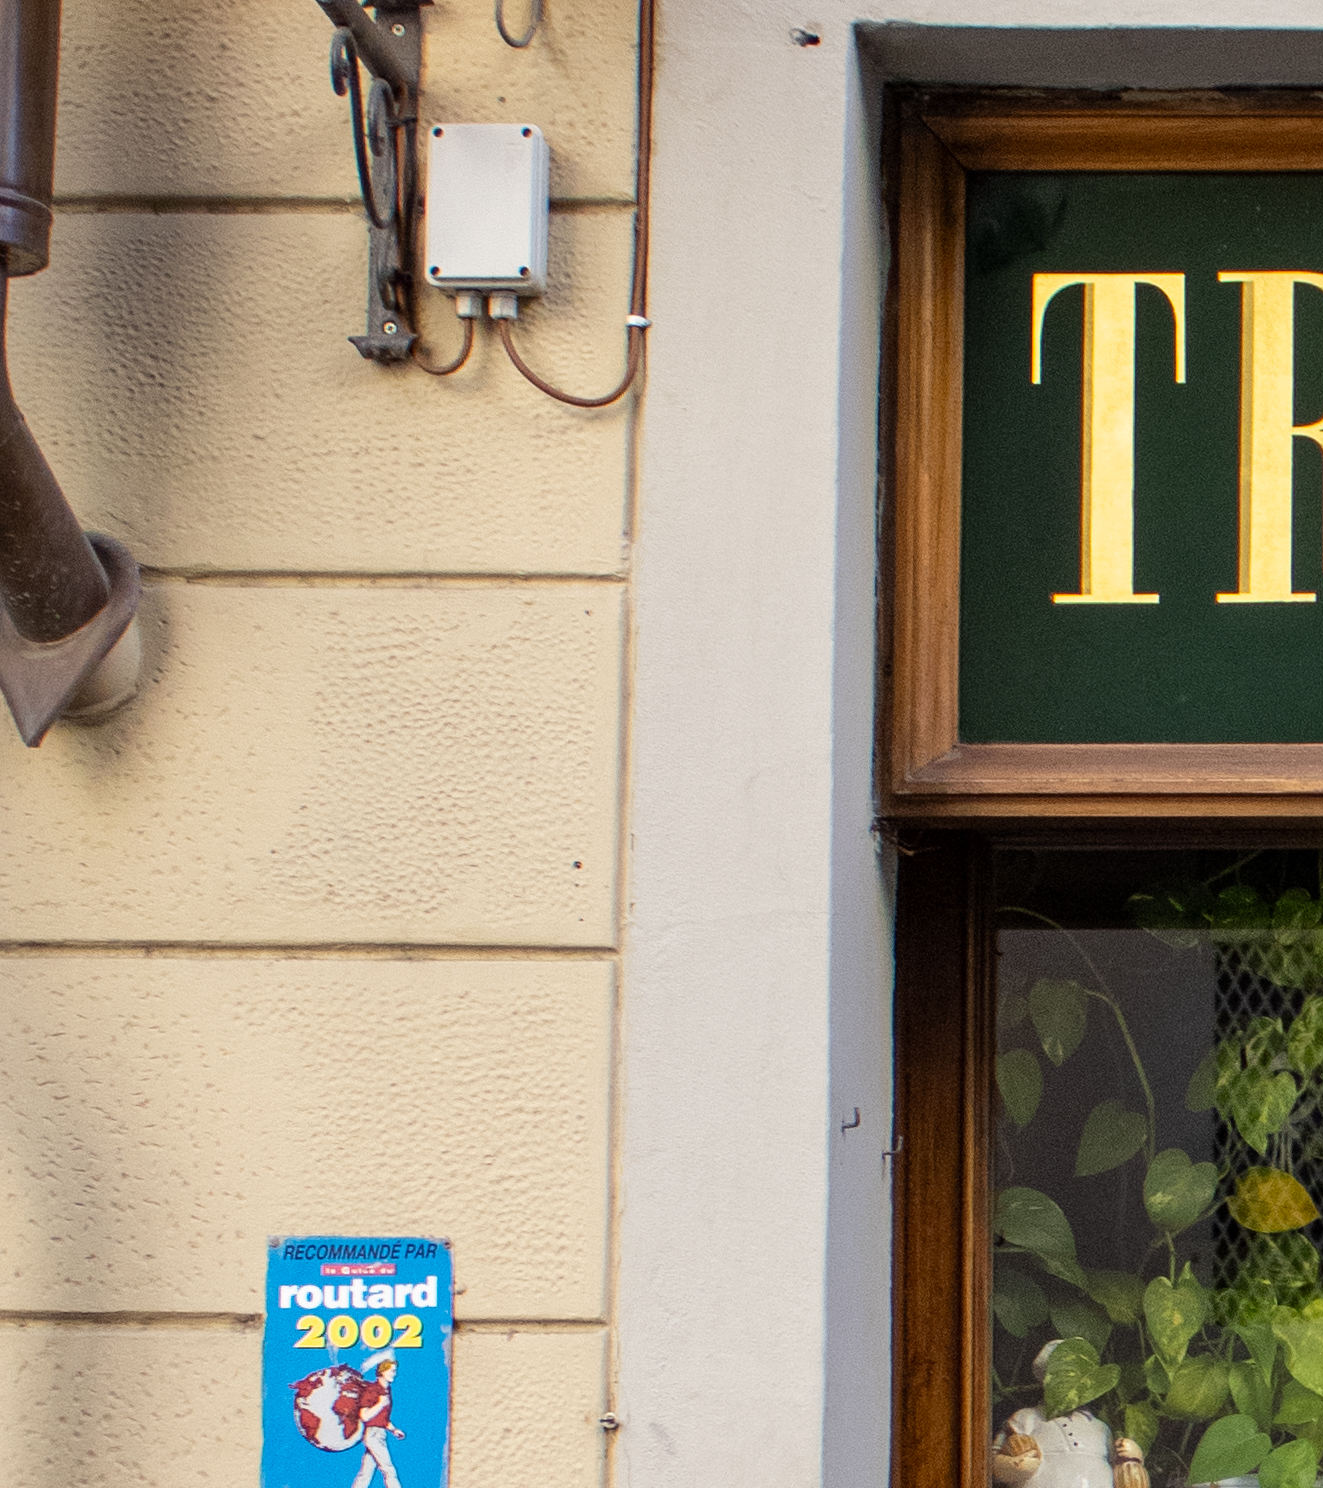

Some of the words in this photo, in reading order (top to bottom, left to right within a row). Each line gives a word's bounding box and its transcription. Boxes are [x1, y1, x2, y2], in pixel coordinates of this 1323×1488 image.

[283, 1240, 402, 1261] RECOMMANDÉ
[405, 1243, 438, 1260] PAR
[278, 1275, 438, 1309] routard
[293, 1314, 423, 1349] 2002
